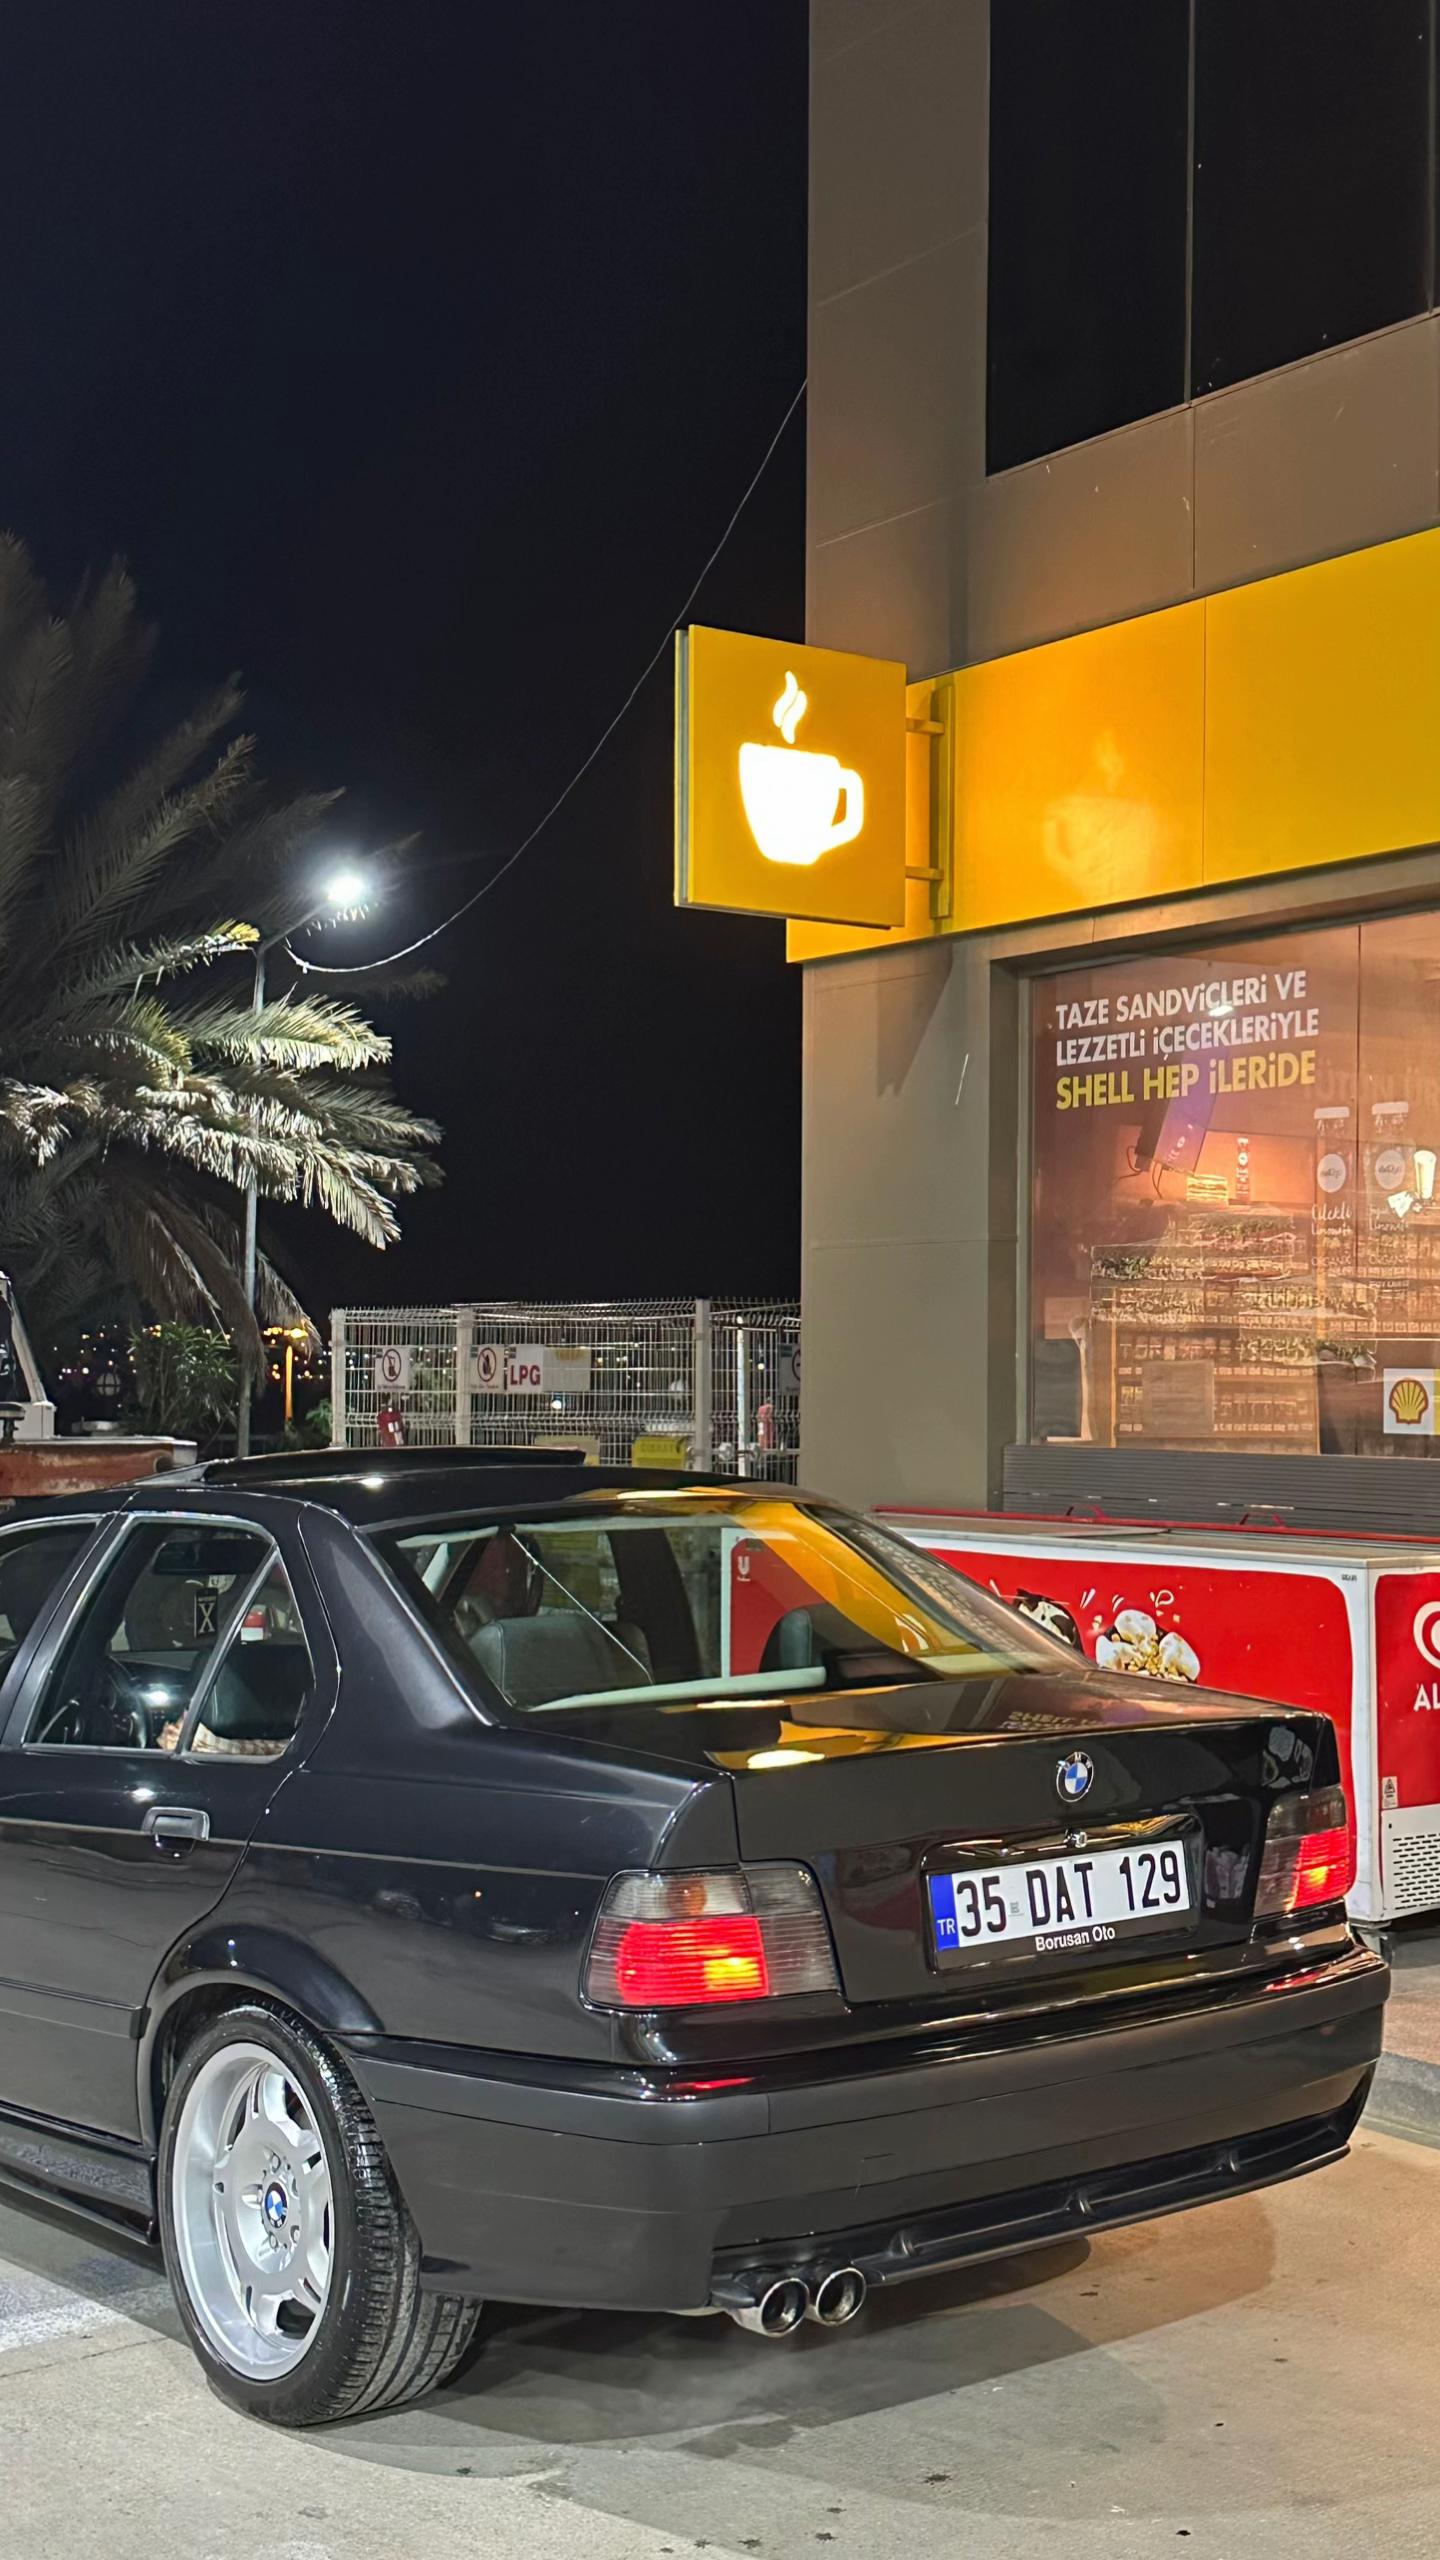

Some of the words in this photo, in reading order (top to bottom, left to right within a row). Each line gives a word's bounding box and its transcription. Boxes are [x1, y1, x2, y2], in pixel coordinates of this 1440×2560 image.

[1056, 999, 1109, 1030] TAZE
[1275, 970, 1307, 1000] VE
[1056, 1068, 1135, 1111] SHELL
[1143, 1063, 1200, 1101] HEP
[510, 1364, 541, 1386] LPG
[956, 1876, 1007, 1938] 35
[1025, 1861, 1094, 1928] DAT
[1119, 1850, 1182, 1911] 129
[937, 1918, 956, 1936] TR
[1035, 1933, 1090, 1952] Borusan
[1092, 1926, 1116, 1942] Oto
